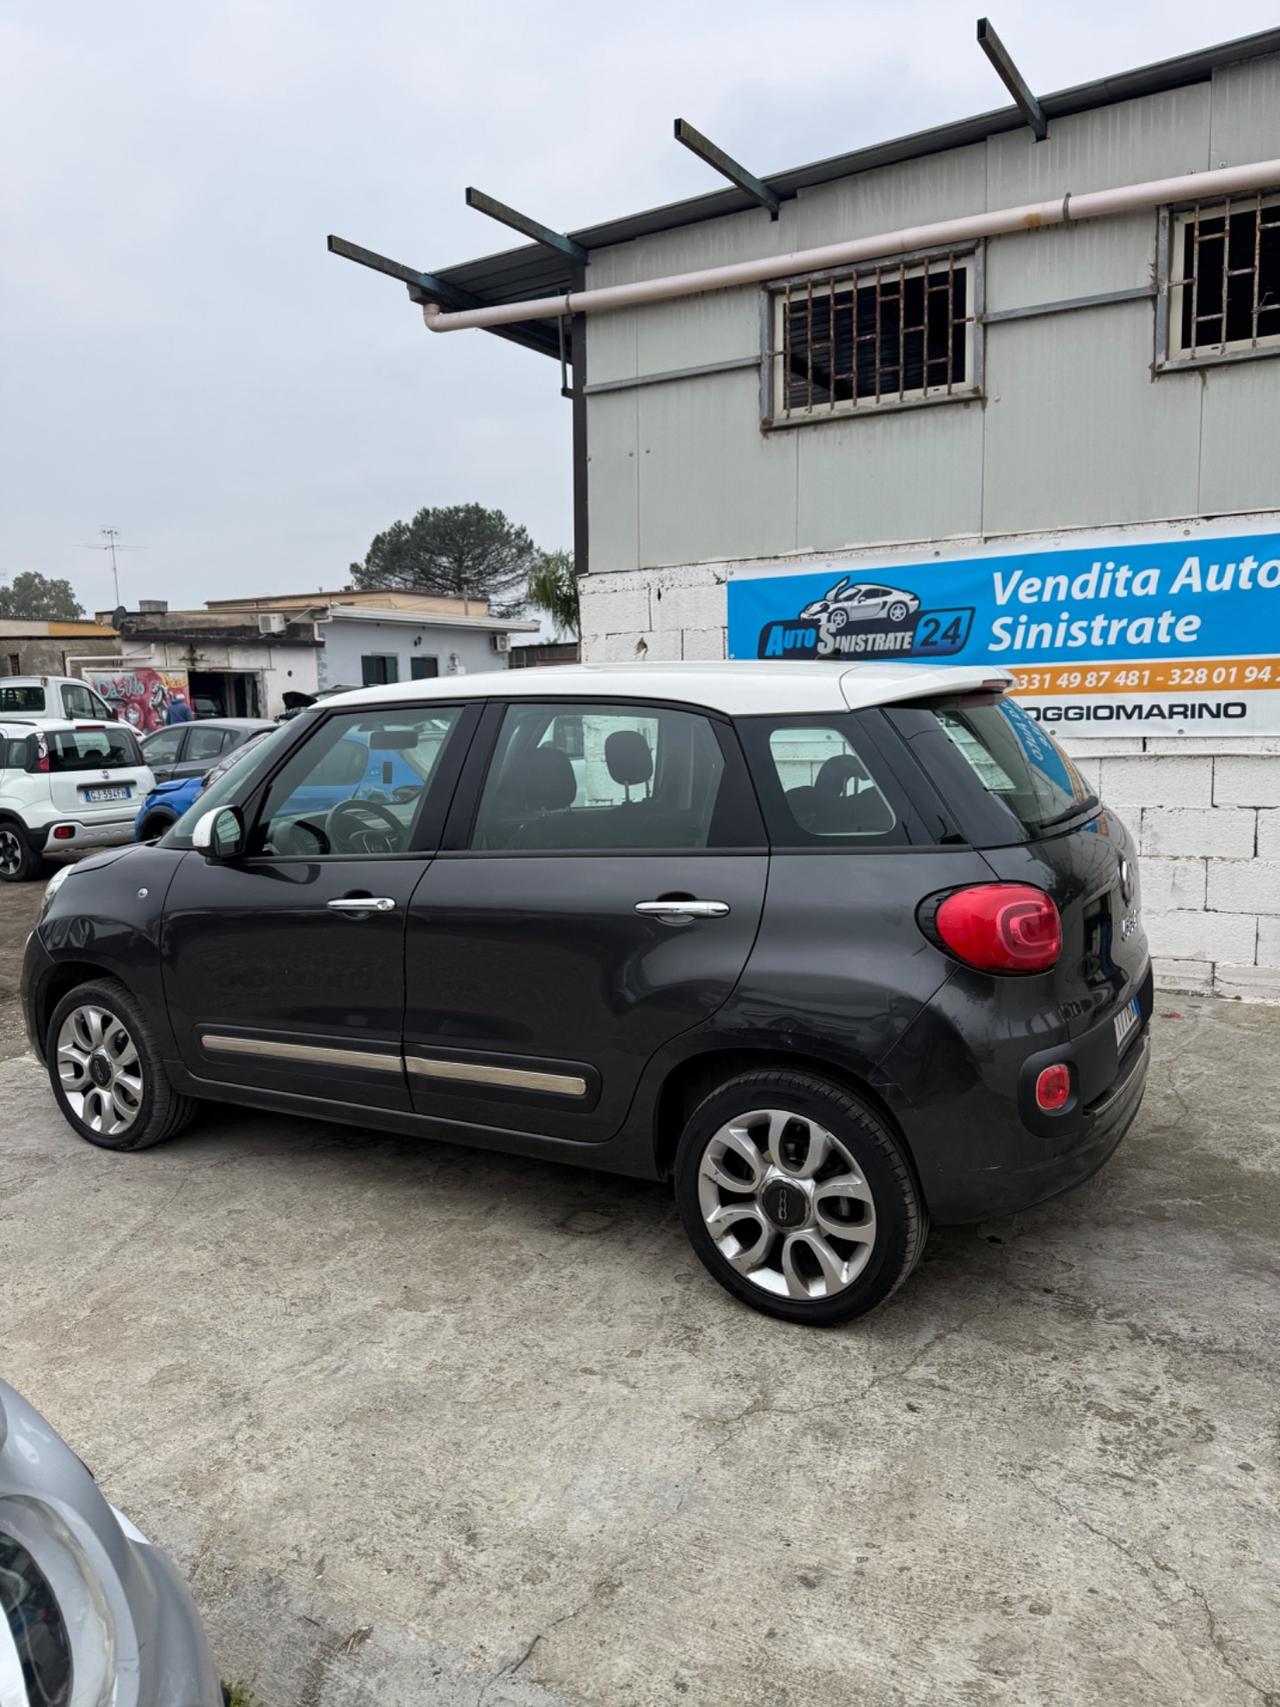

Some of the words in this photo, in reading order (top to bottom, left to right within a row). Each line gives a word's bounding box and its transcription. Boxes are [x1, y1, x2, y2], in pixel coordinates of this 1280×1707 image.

[992, 562, 1161, 606] Vendita
[1170, 554, 1280, 595] Auto
[920, 616, 963, 647] 24
[987, 610, 1202, 652] Sinistrate
[1018, 673, 1051, 690] 331
[1056, 671, 1082, 688] 49
[1085, 670, 1112, 687] 87
[1114, 669, 1151, 687] 481
[1170, 667, 1208, 685] 328
[1212, 666, 1238, 684] 01
[1244, 665, 1272, 683] 94
[1022, 702, 1247, 723] OGGIOMARINO
